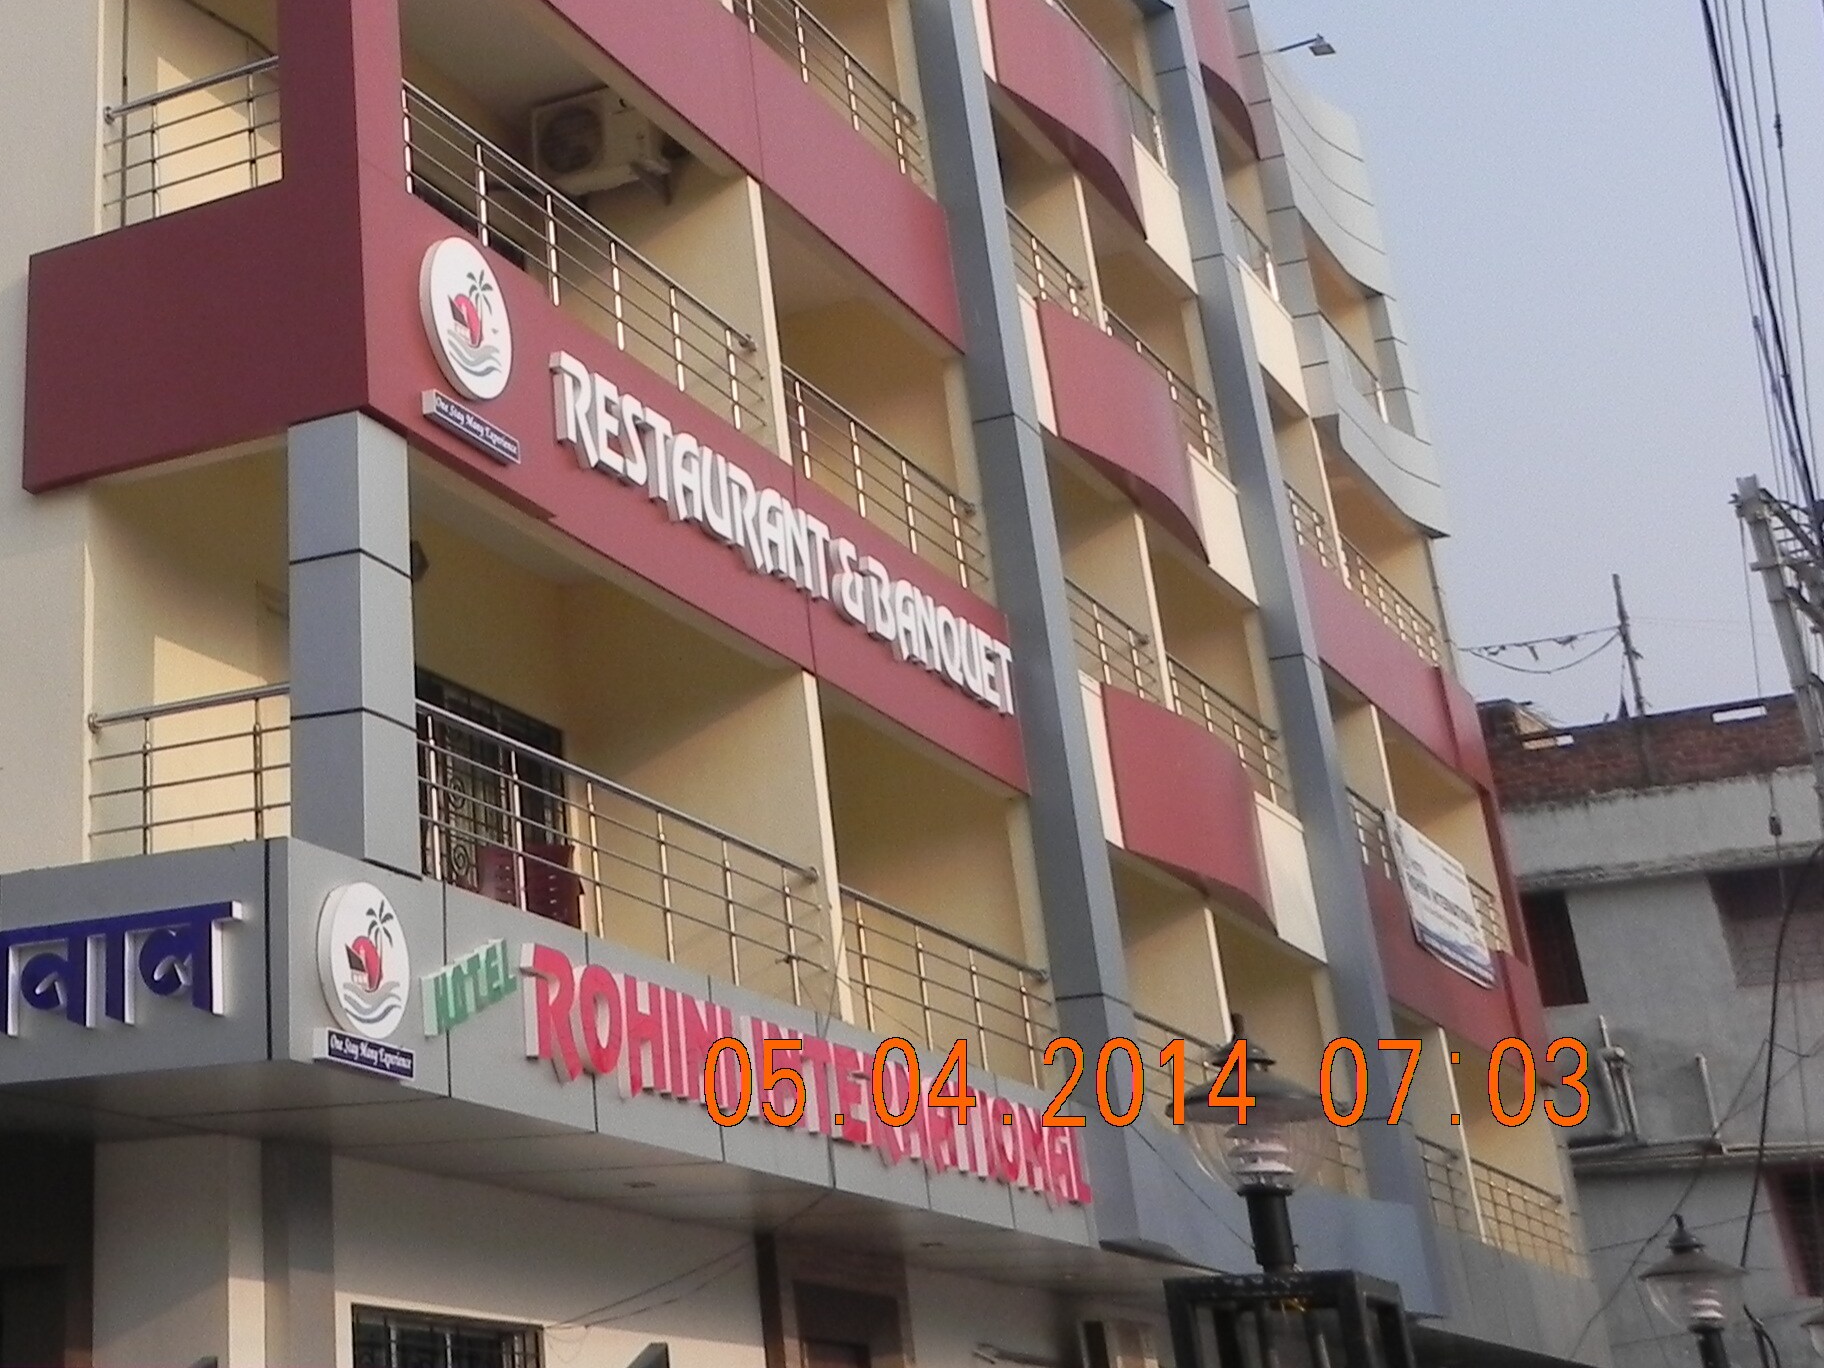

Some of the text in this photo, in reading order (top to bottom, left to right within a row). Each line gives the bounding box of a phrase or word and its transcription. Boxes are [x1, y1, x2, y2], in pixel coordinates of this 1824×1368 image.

[549, 350, 1015, 717] RESTAURANT & BANQUET
[420, 938, 518, 1036] HOTEL
[520, 943, 740, 1112] ROHINI
